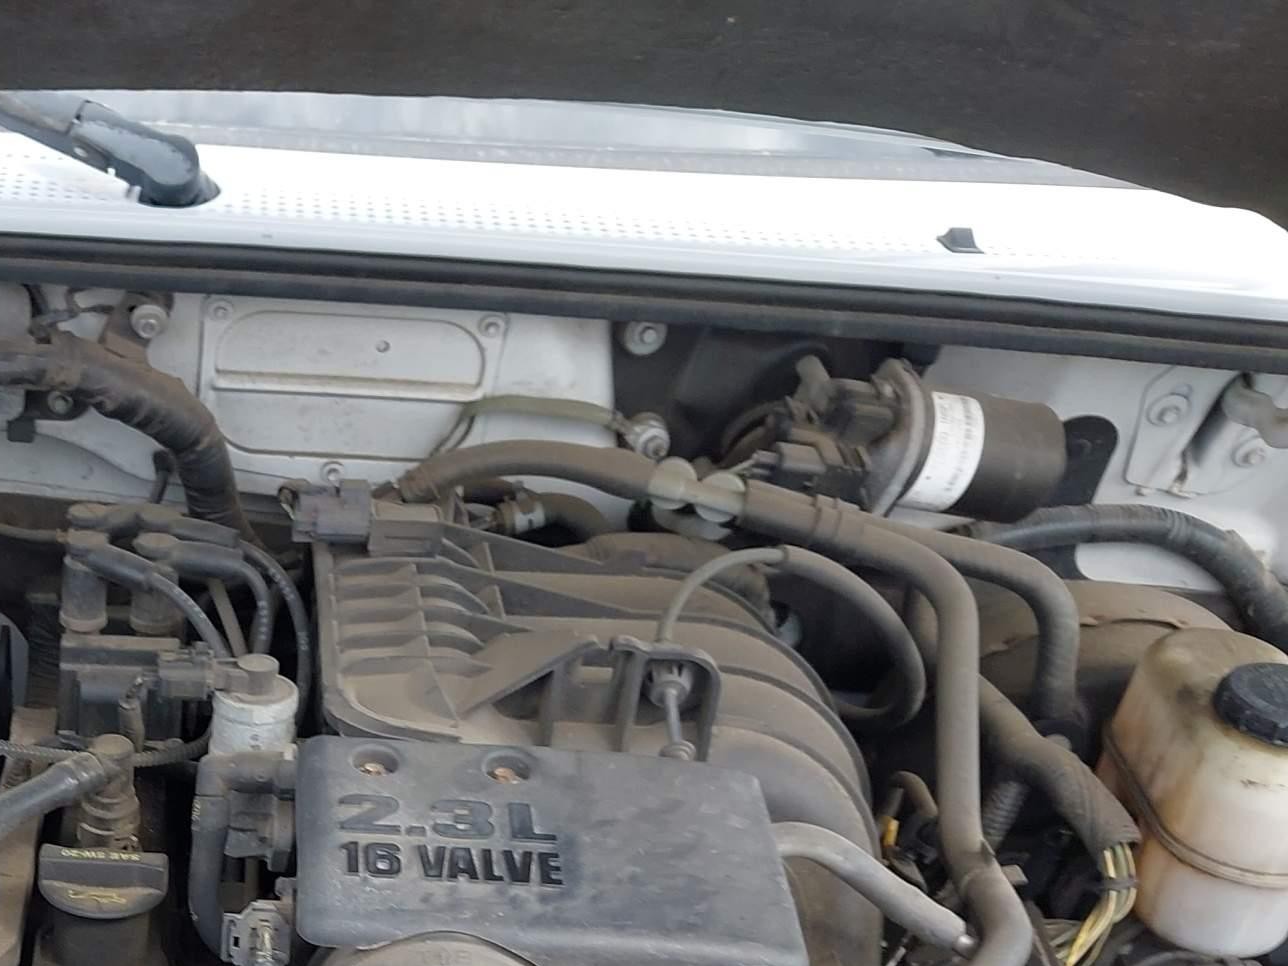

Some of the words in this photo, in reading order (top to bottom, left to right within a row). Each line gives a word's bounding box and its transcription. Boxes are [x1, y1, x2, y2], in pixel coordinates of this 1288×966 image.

[338, 793, 557, 842] 2.3L
[339, 841, 402, 878] 16
[417, 844, 564, 886] VALVE
